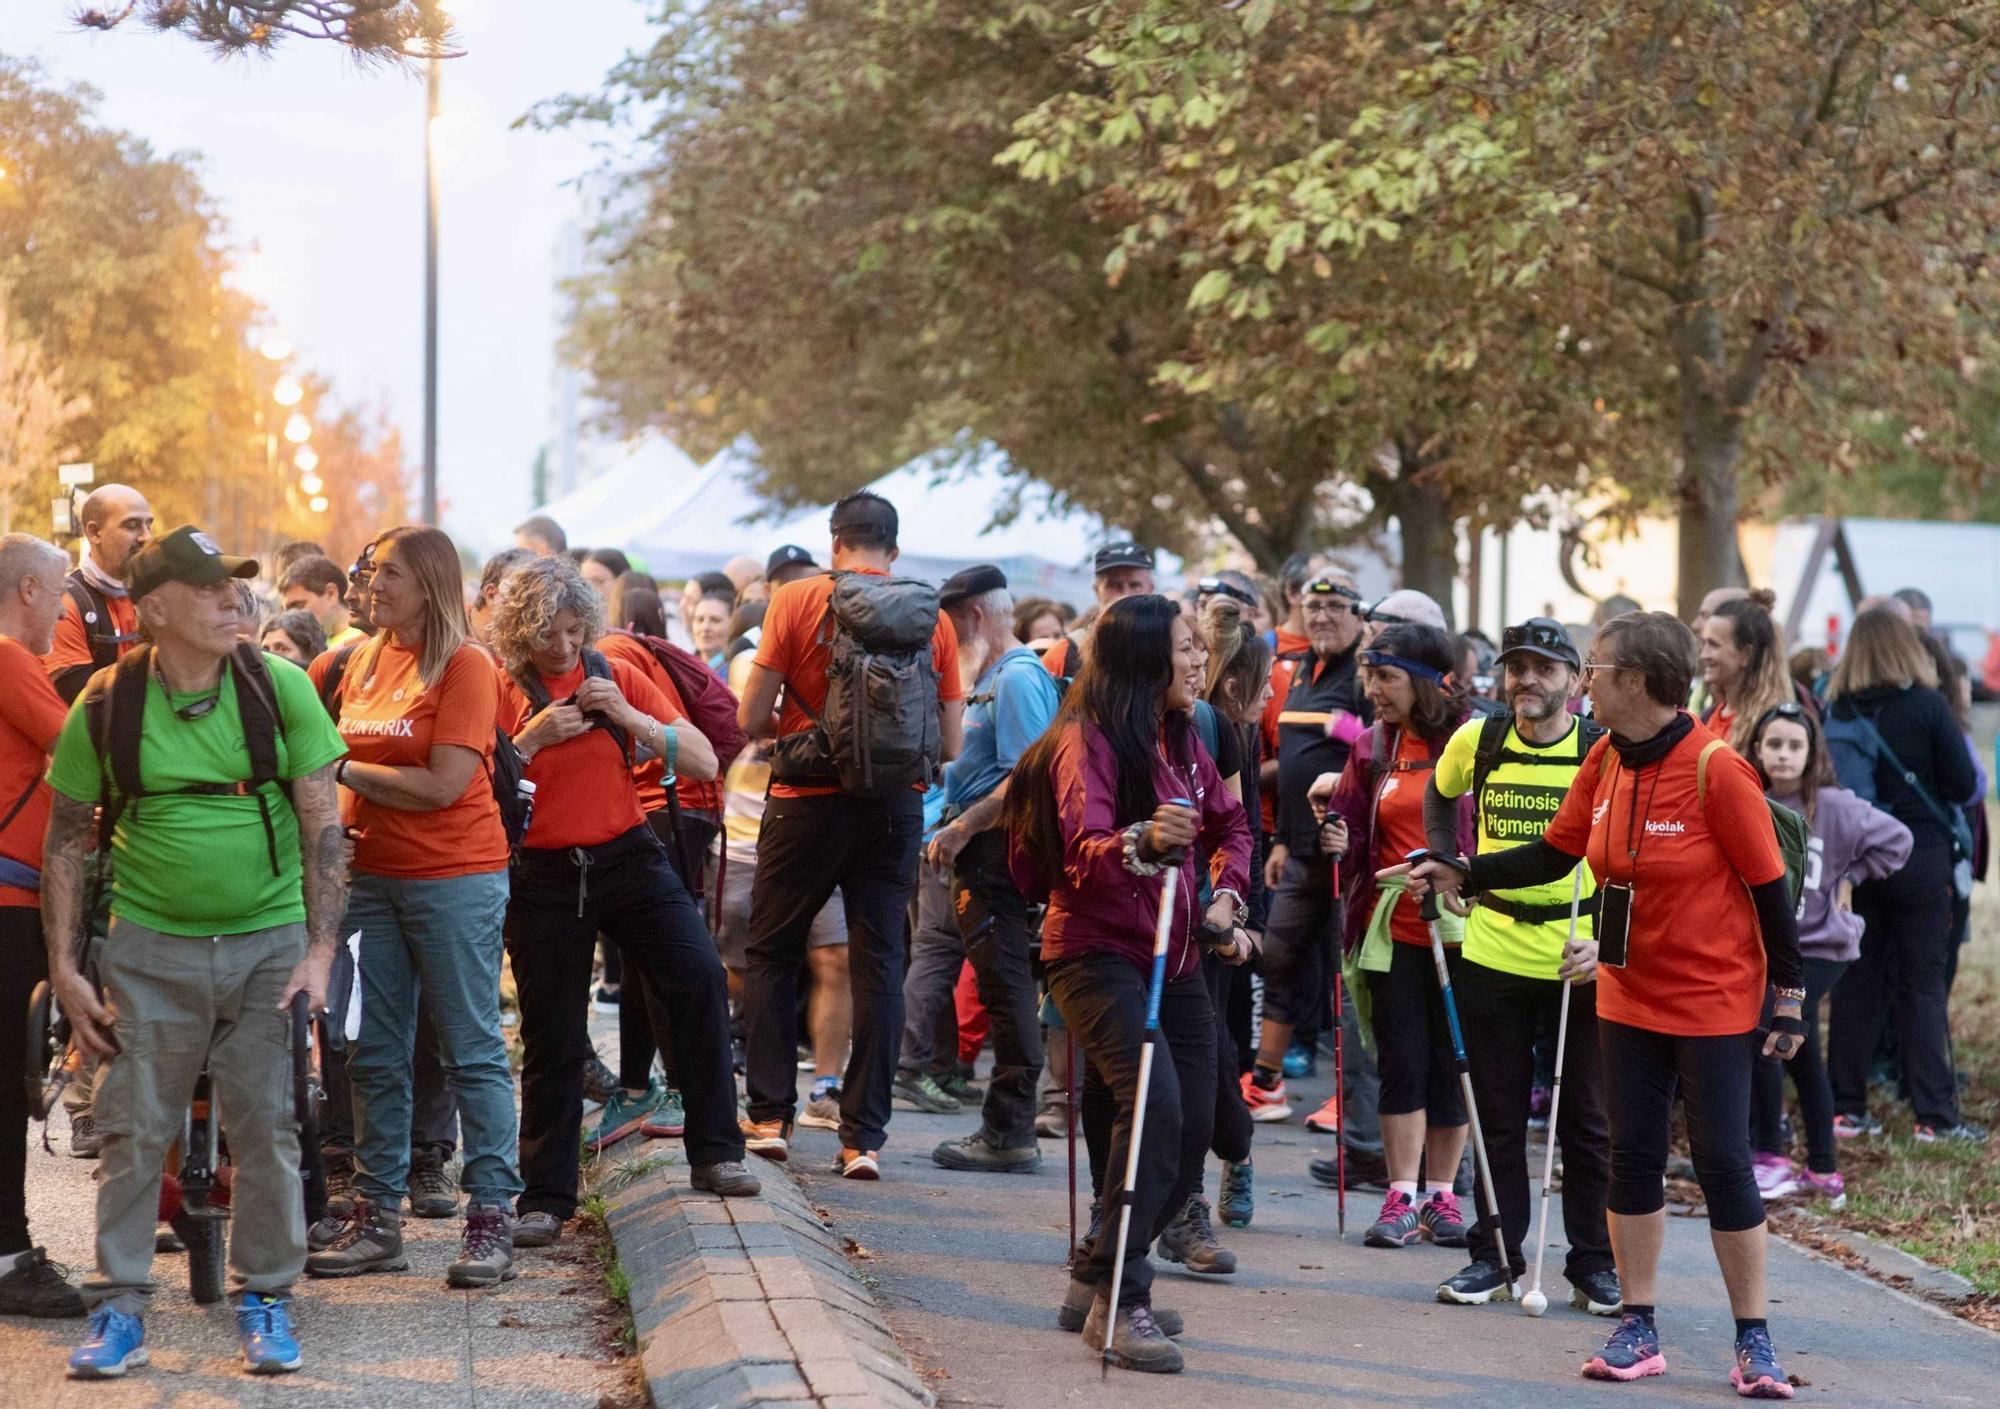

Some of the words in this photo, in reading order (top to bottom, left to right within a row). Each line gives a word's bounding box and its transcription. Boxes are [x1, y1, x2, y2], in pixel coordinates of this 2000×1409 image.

[336, 718, 414, 736] OLUNTARIX
[1485, 789, 1560, 811] Retinosis
[1487, 813, 1550, 837] Pigment
